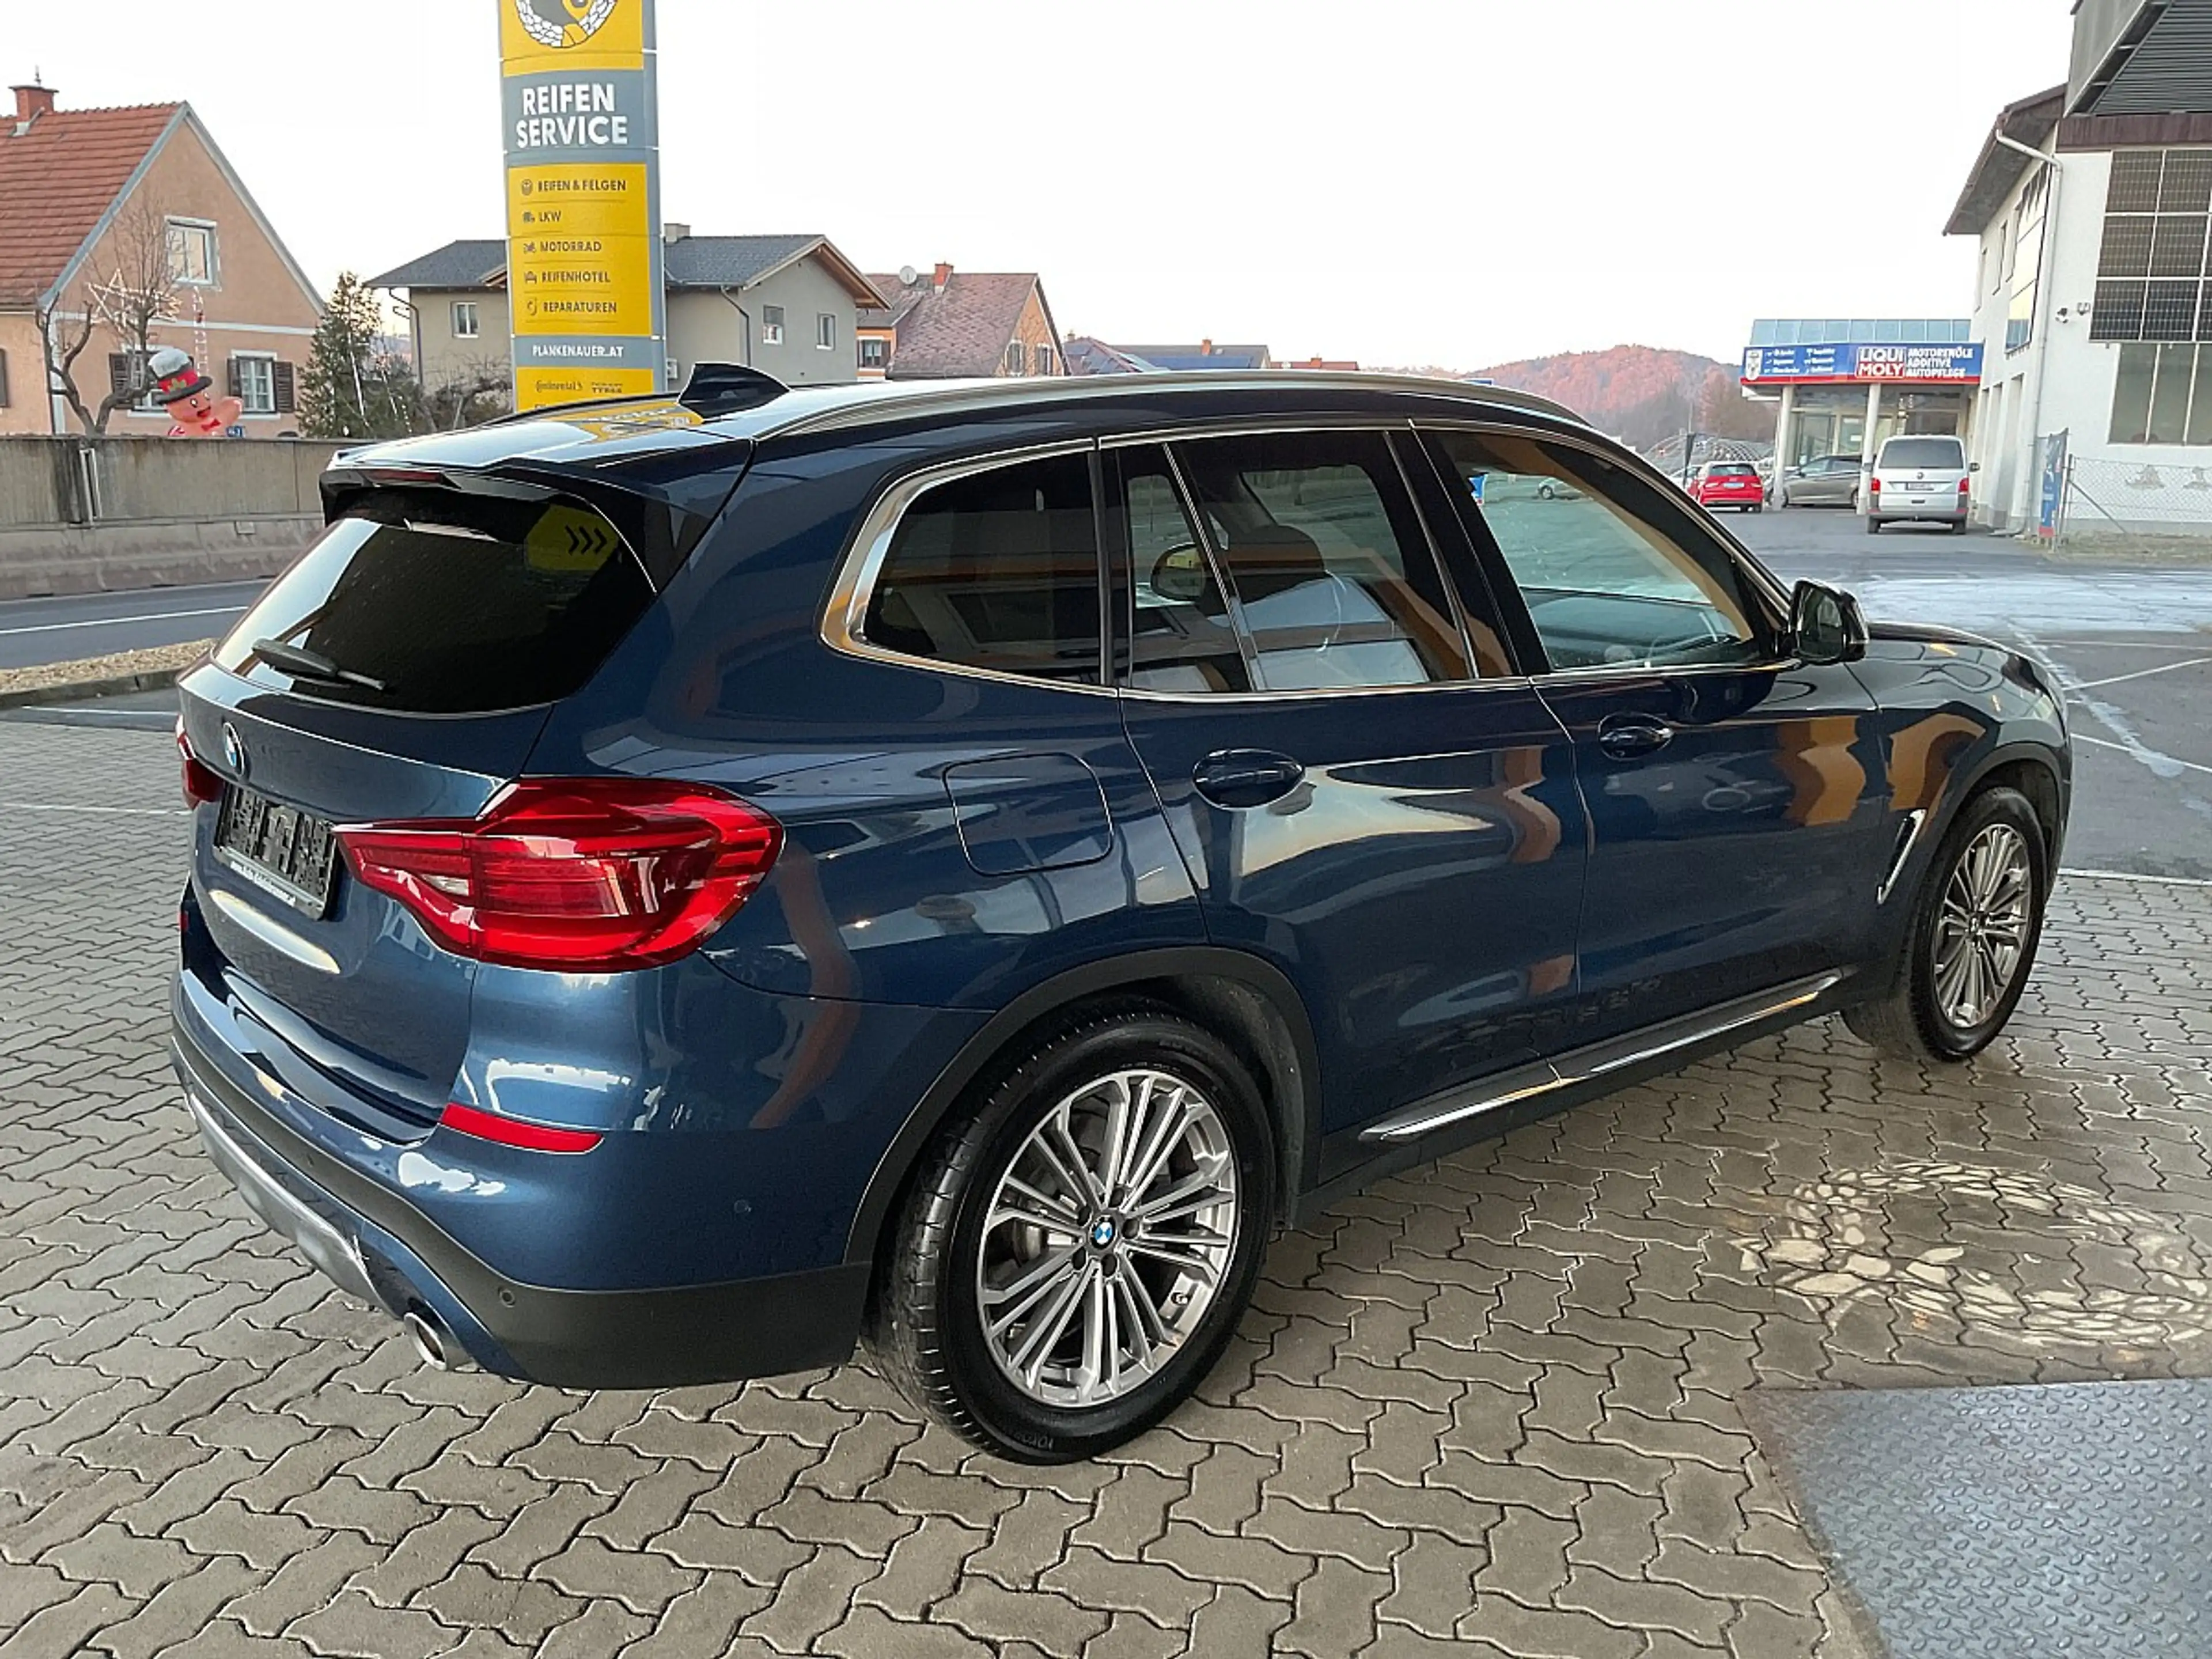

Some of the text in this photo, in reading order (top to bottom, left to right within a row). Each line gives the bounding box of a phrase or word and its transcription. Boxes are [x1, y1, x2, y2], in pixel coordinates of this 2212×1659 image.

[522, 84, 615, 115] REIFEN
[516, 116, 628, 148] SERVICE
[582, 180, 626, 191] FELGEN
[539, 211, 561, 222] LKW
[540, 241, 601, 252] MOTORRAD
[541, 271, 611, 283] REIFENHOTEL
[543, 302, 617, 313] REPARATUREN
[532, 345, 623, 357] PLANKENAUER.AT
[1860, 347, 1904, 362] LIQUI
[1908, 347, 1973, 358] MOTORENÖLE
[1908, 358, 1951, 368] ADDITIVE
[1858, 363, 1903, 377] MOLY
